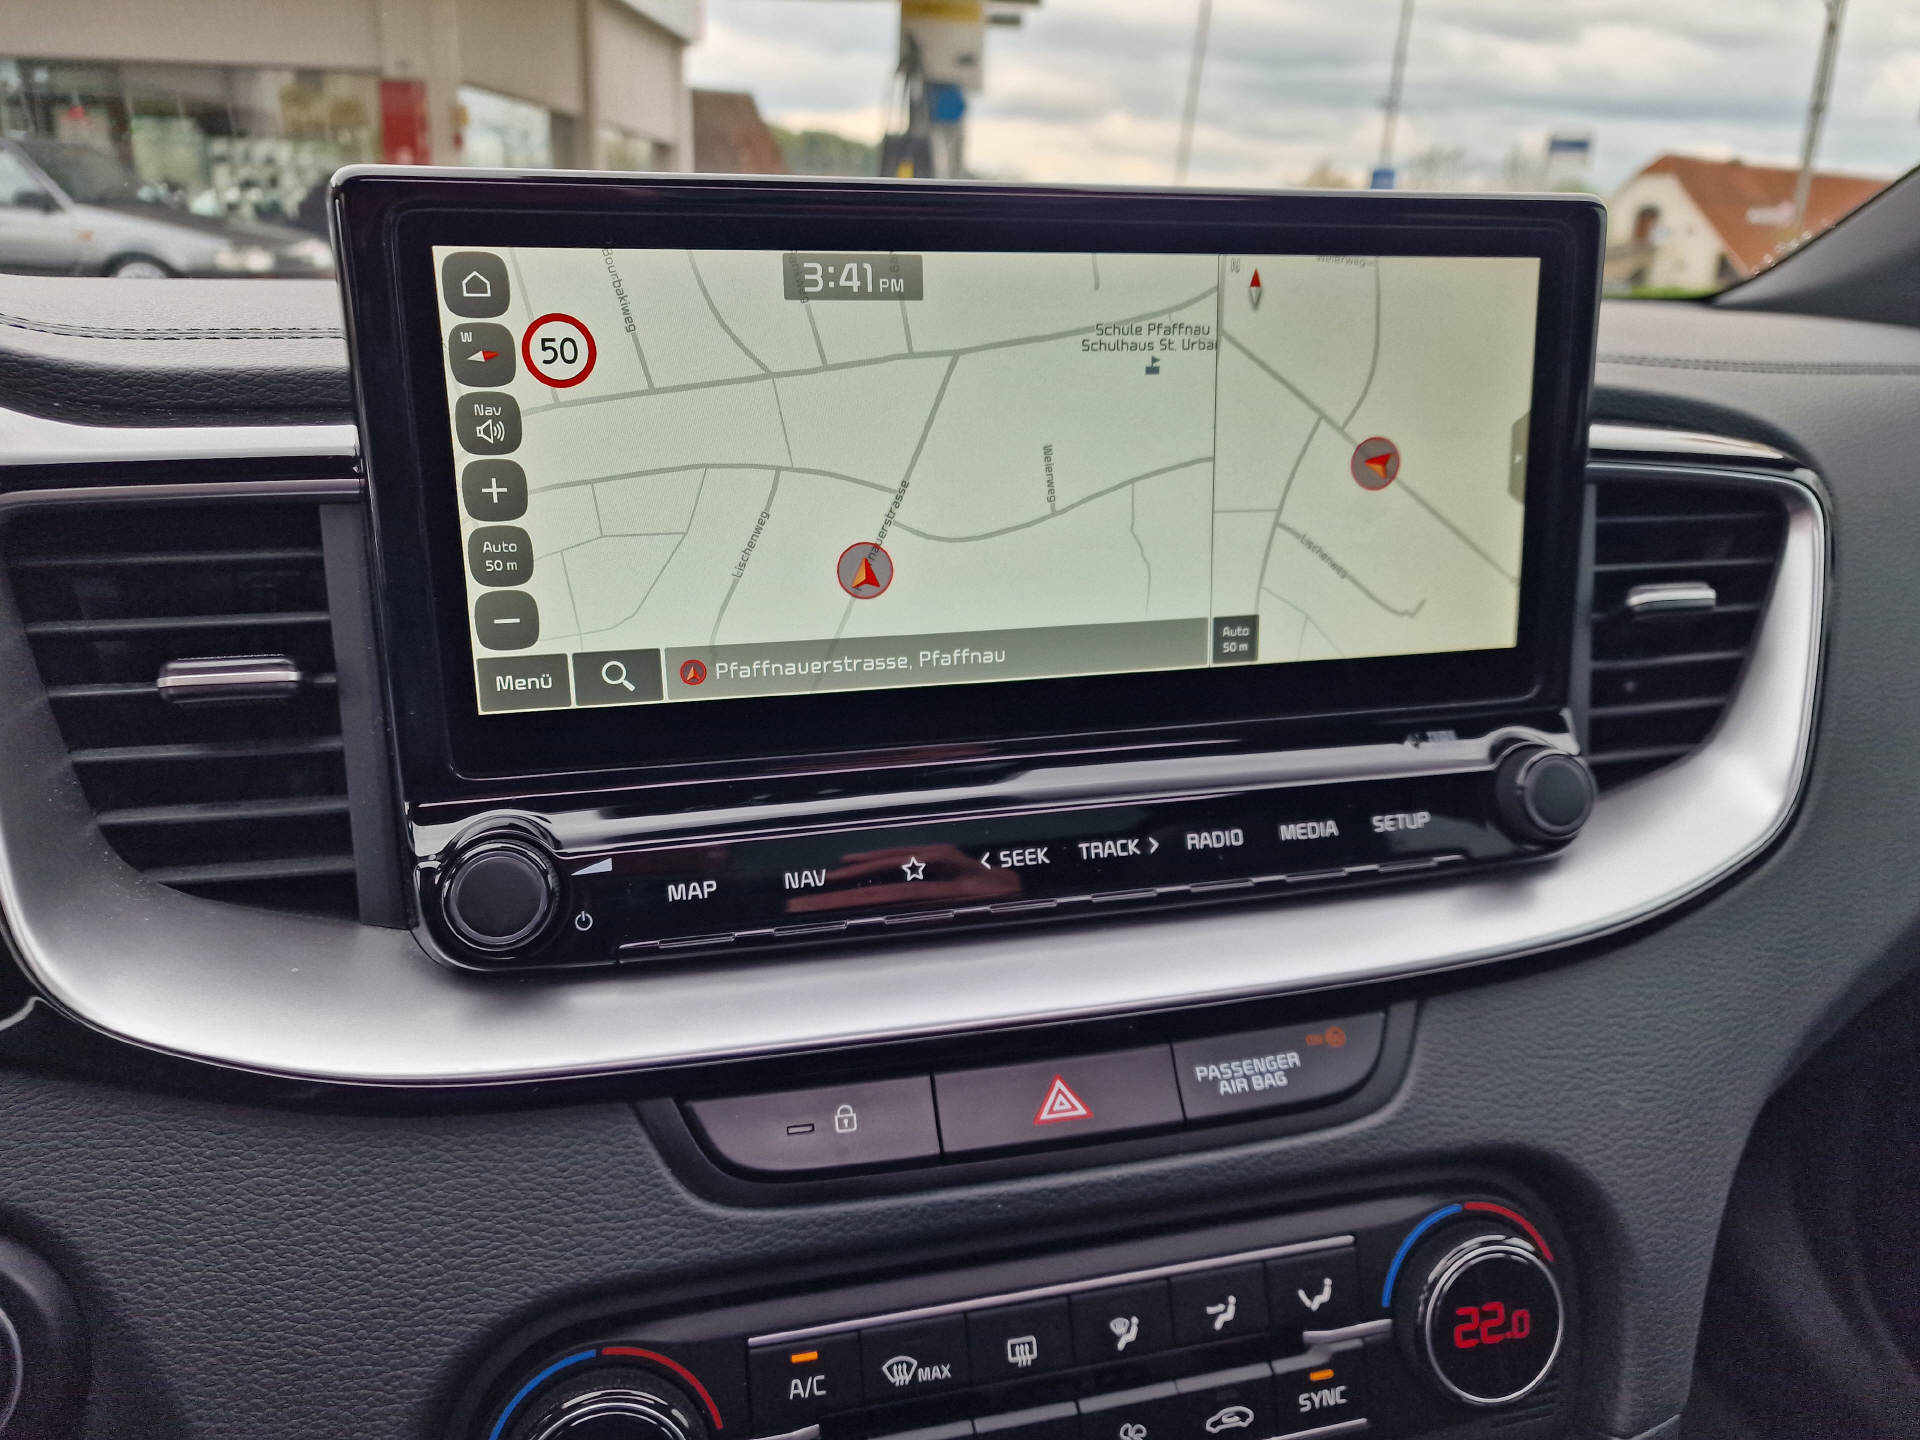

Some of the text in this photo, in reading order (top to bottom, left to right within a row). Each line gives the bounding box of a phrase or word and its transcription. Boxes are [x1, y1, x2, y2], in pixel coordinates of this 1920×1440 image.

[803, 262, 873, 293] 3:41
[879, 278, 904, 293] PM
[460, 331, 473, 343] W
[1095, 322, 1211, 336] Schule Pfaffnau
[540, 337, 579, 365] 50
[1081, 338, 1154, 352] Schulhaus
[474, 404, 502, 416] Nav
[1043, 444, 1056, 503] Weierweg
[482, 541, 518, 553] Auto
[731, 511, 770, 578] Lischenweg
[485, 560, 518, 572] 50 m
[1222, 626, 1250, 637] Auto
[1223, 642, 1248, 653] 50 m
[715, 648, 1006, 679] Pfaffnauerstrasse, Pfaffnau
[495, 673, 553, 692] Menü
[1279, 819, 1339, 842] MEDIA
[1371, 811, 1431, 835] SETUP
[1078, 839, 1141, 861] TRACK
[1186, 828, 1244, 851] RADIO
[999, 846, 1051, 868] SEEK
[783, 869, 827, 890] NAV
[667, 880, 717, 903] MAP
[1195, 1051, 1301, 1082] PASSENGER
[1219, 1071, 1289, 1096] AIR BAG
[1453, 1301, 1531, 1349] 22.0
[917, 1362, 953, 1384] MAX
[788, 1374, 827, 1400] A/C
[1298, 1385, 1348, 1413] SYNC
